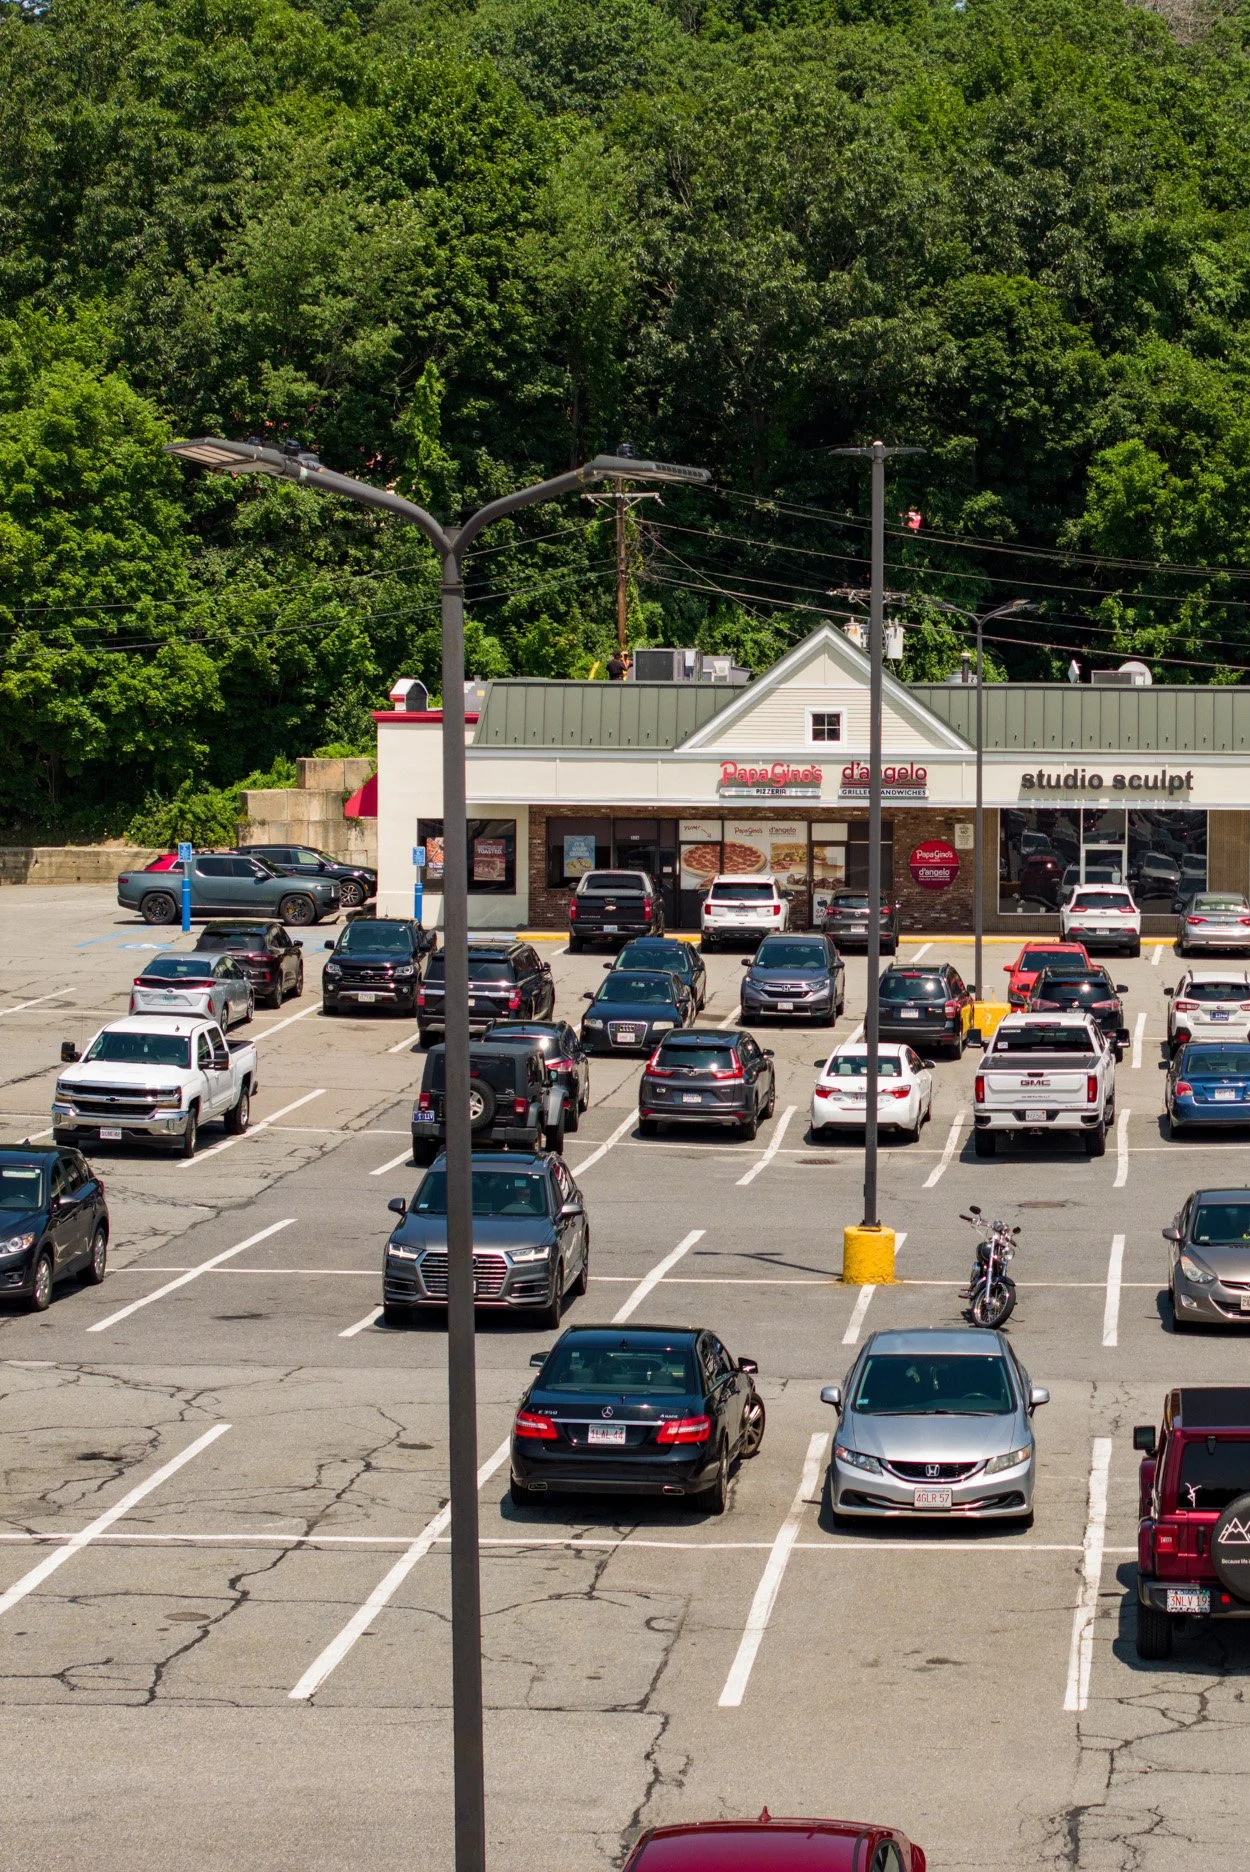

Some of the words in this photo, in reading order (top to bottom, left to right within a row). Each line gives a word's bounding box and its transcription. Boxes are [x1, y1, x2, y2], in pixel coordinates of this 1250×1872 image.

[1021, 768, 1104, 790] studio
[1112, 769, 1194, 796] sculpt
[769, 826, 797, 835] d'angelo
[918, 868, 950, 877] d'angelo
[916, 1493, 937, 1503] 4GLR
[939, 1493, 950, 1503] 57
[1170, 1595, 1193, 1607] 3NLV
[1197, 1595, 1208, 1606] 19
